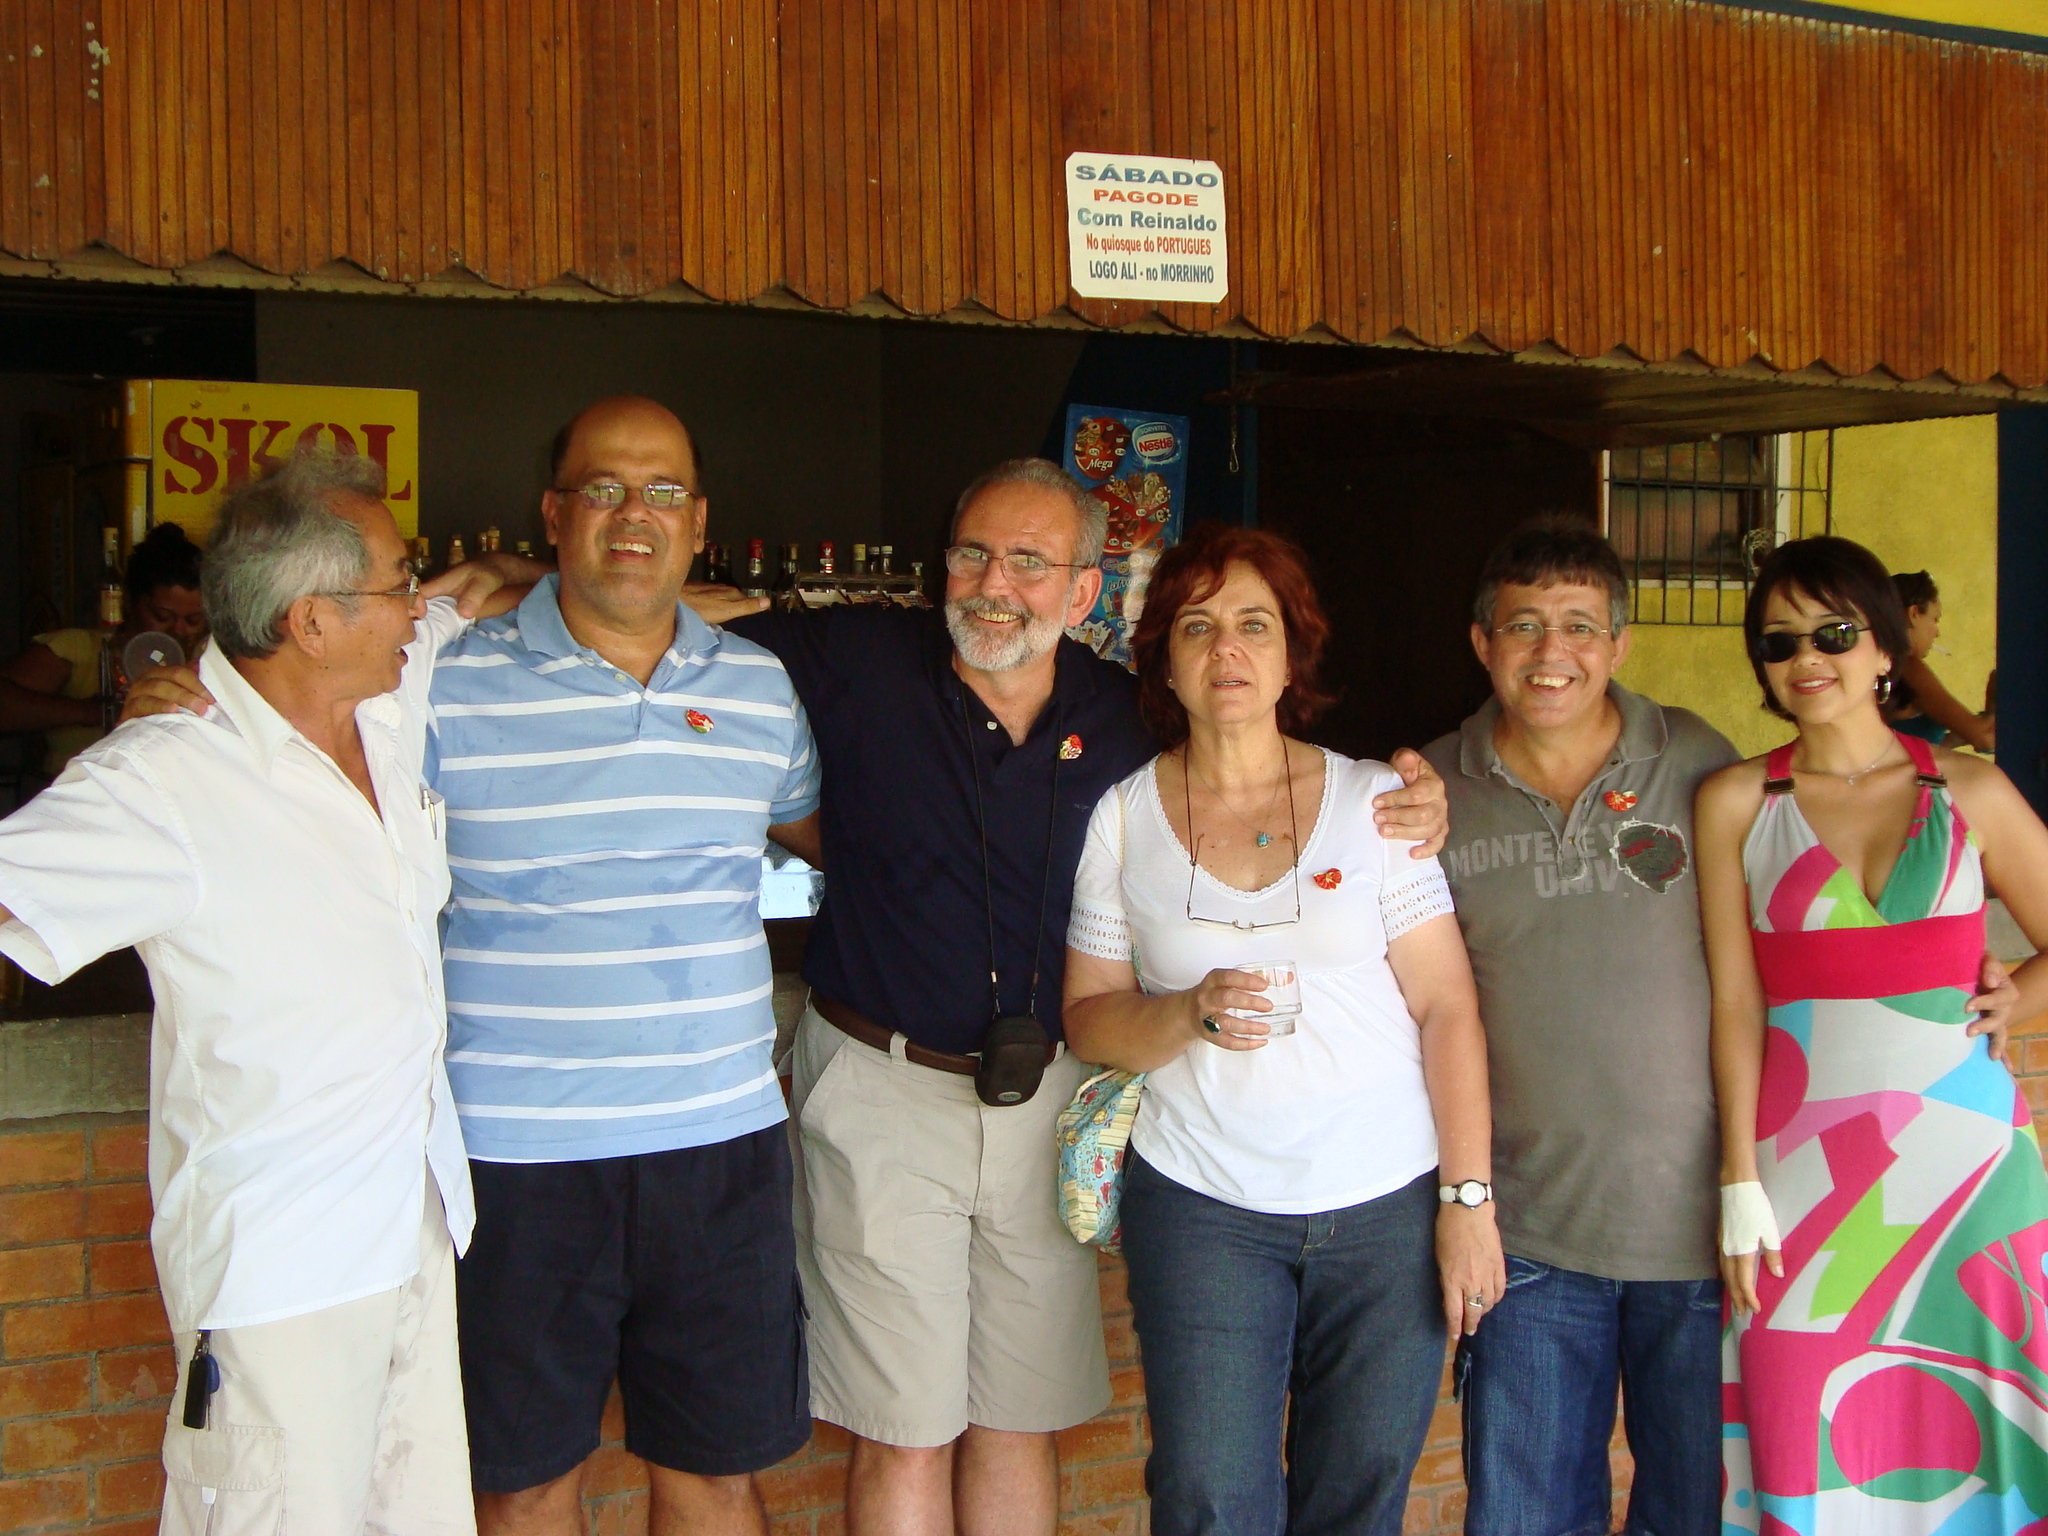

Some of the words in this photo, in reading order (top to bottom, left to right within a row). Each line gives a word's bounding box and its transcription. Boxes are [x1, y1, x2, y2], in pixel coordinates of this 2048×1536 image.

[1076, 164, 1218, 187] SÁBADO
[1094, 189, 1199, 206] PAGODE
[1077, 207, 1123, 227] Com
[1130, 210, 1217, 231] Reinaldo
[1086, 233, 1099, 250] No
[1101, 234, 1141, 255] quiosque
[1143, 236, 1154, 252] do
[1156, 236, 1211, 255] PORTUGUES
[1090, 260, 1118, 279] LOGO
[1121, 261, 1137, 280] ALI
[1146, 267, 1158, 281] no
[1161, 263, 1214, 283] MORRINHO
[1087, 457, 1114, 471] Mega
[1449, 821, 1622, 879] MONTEEY
